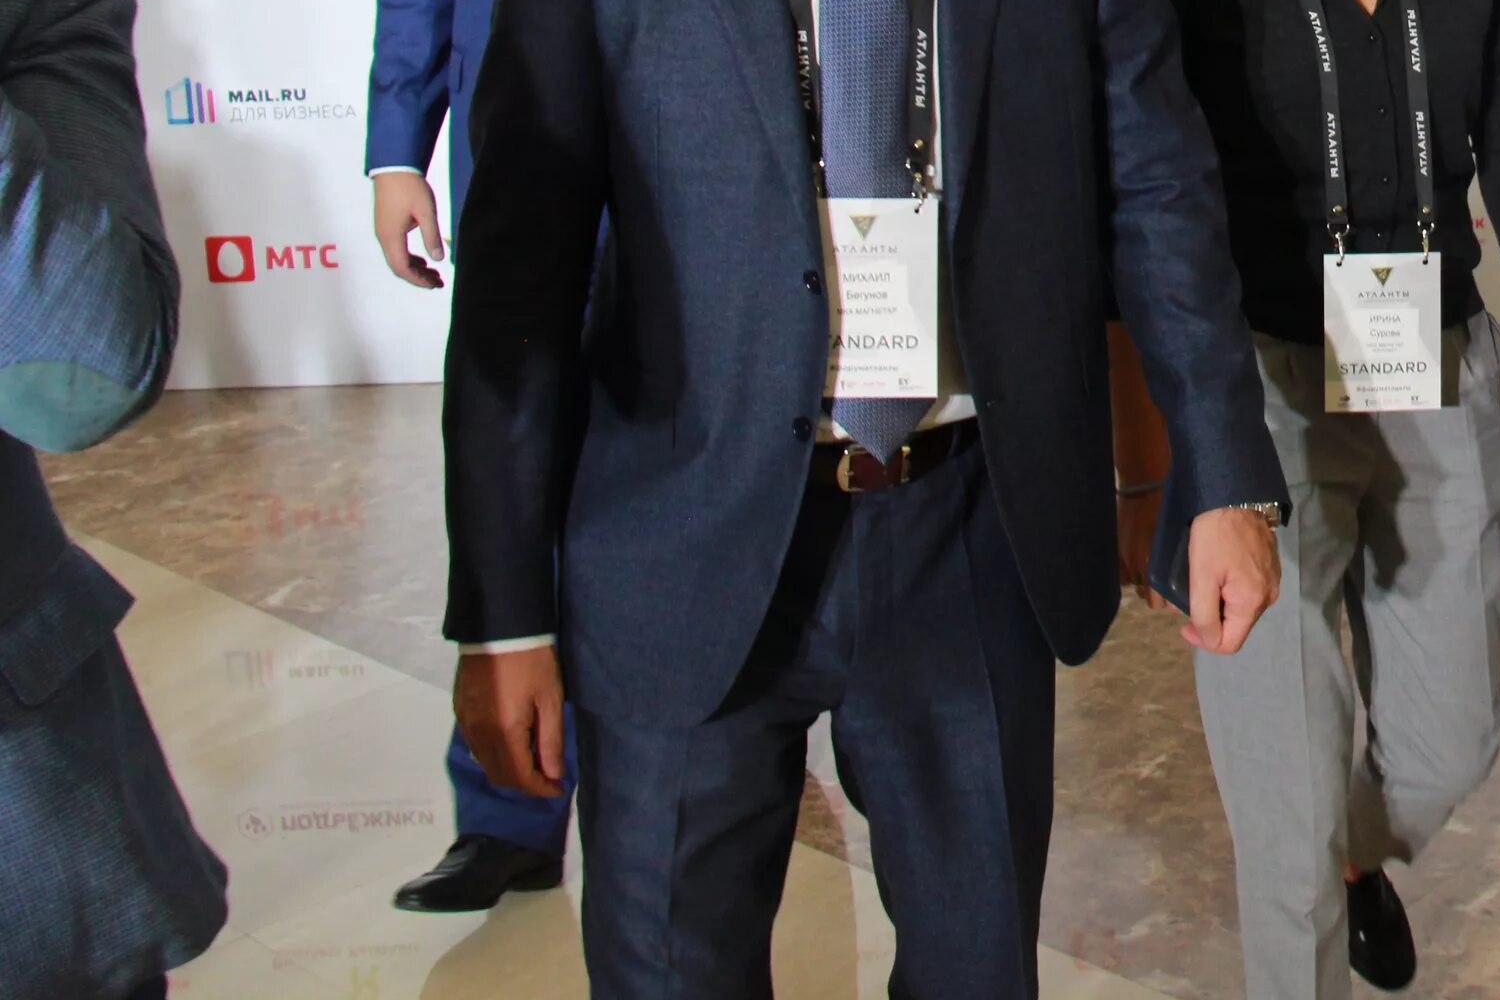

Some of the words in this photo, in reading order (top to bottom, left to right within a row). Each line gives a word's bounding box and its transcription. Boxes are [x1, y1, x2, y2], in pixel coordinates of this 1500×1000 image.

[1308, 10, 1332, 73] АТЛАНТЫ
[1406, 9, 1422, 73] АТЛАНТЫ
[915, 28, 928, 109] АТЛАНТЫ
[228, 88, 307, 102] MAIL.RU
[228, 105, 267, 123] ДЛЯ
[273, 104, 357, 121] БИЗНЕСА
[1326, 111, 1340, 179] АТЛАНТЫ
[1415, 111, 1428, 177] АТЛАНТЫ
[265, 244, 339, 271] МТС
[842, 272, 890, 284] МИХАИЛ
[830, 334, 919, 350] ANDARD
[1339, 361, 1428, 375] STANDARD
